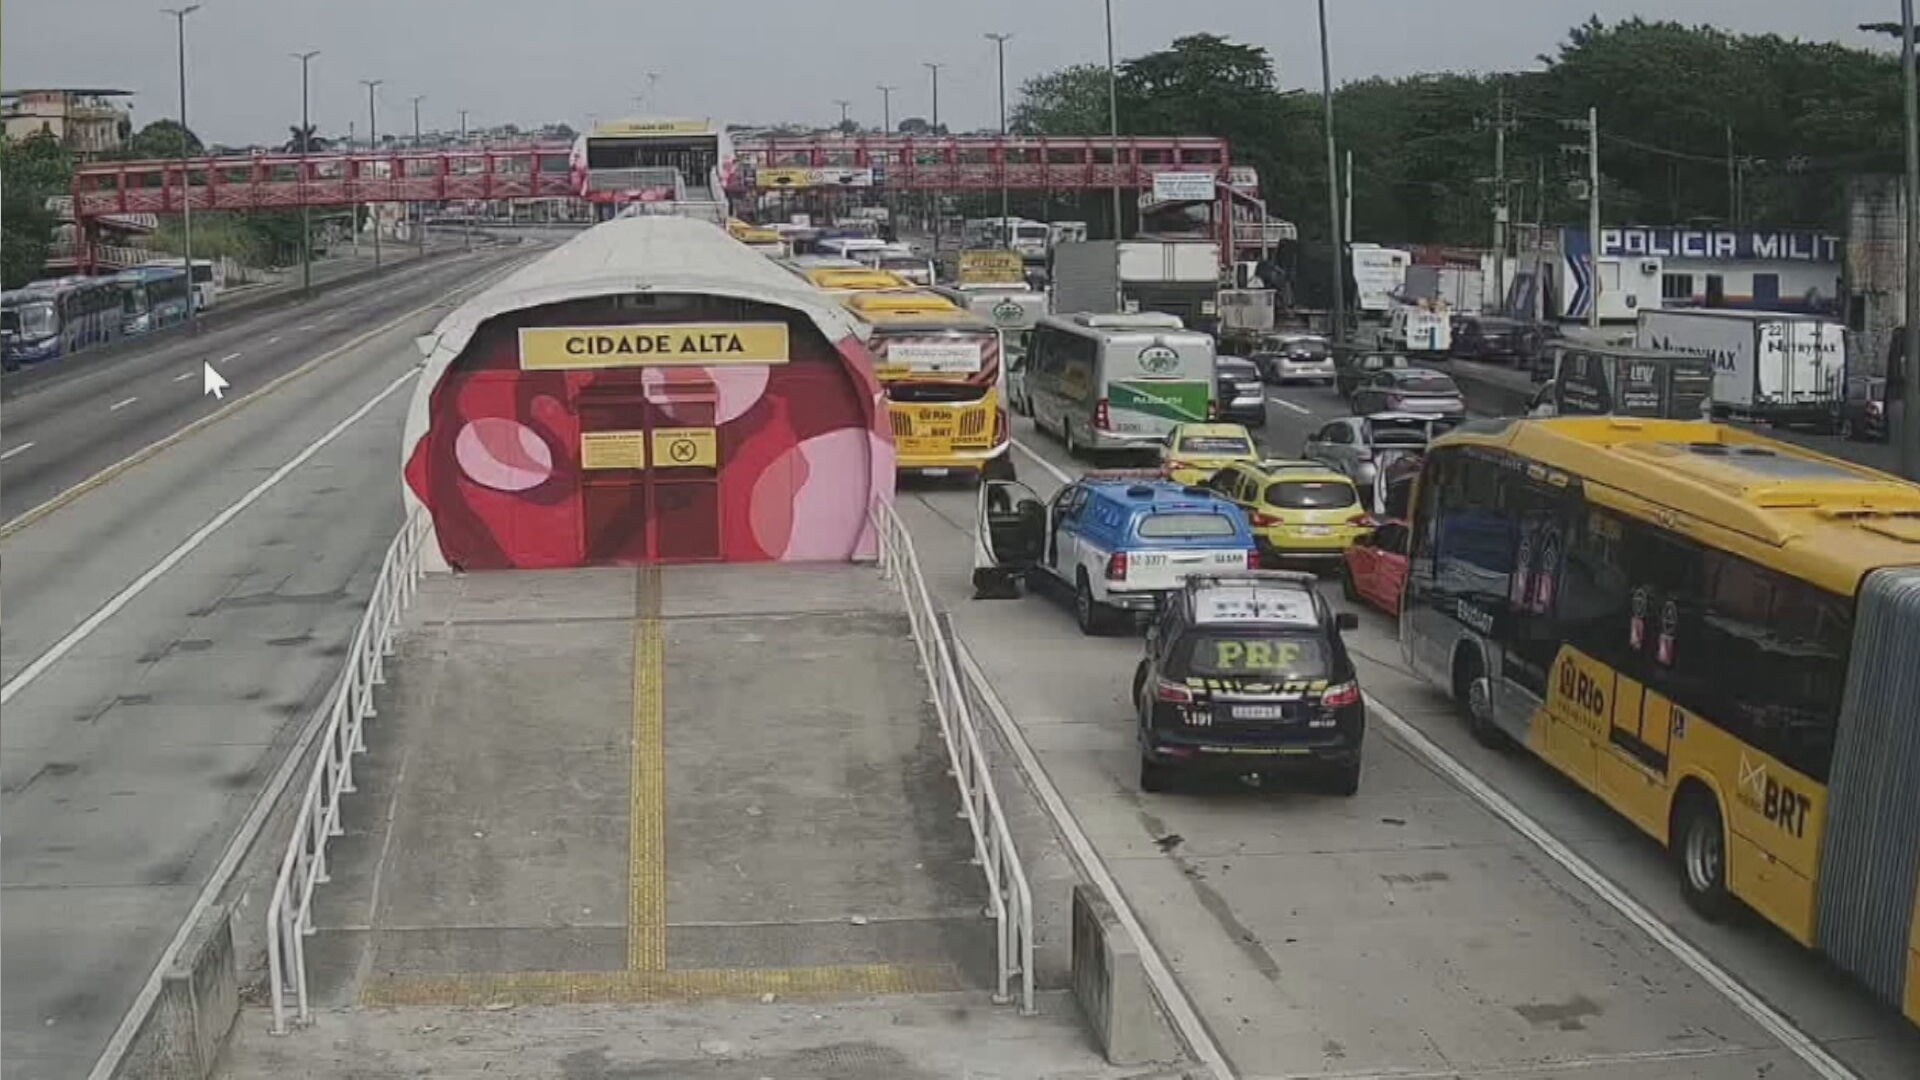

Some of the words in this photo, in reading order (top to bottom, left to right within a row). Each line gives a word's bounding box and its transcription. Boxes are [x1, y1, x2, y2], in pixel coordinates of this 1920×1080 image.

[1601, 229, 1736, 257] POLICIA
[565, 335, 671, 355] CIDADE
[679, 334, 744, 353] ALTA
[1768, 325, 1782, 337] 22
[1216, 640, 1301, 668] PRF
[1763, 775, 1812, 838] BRT
